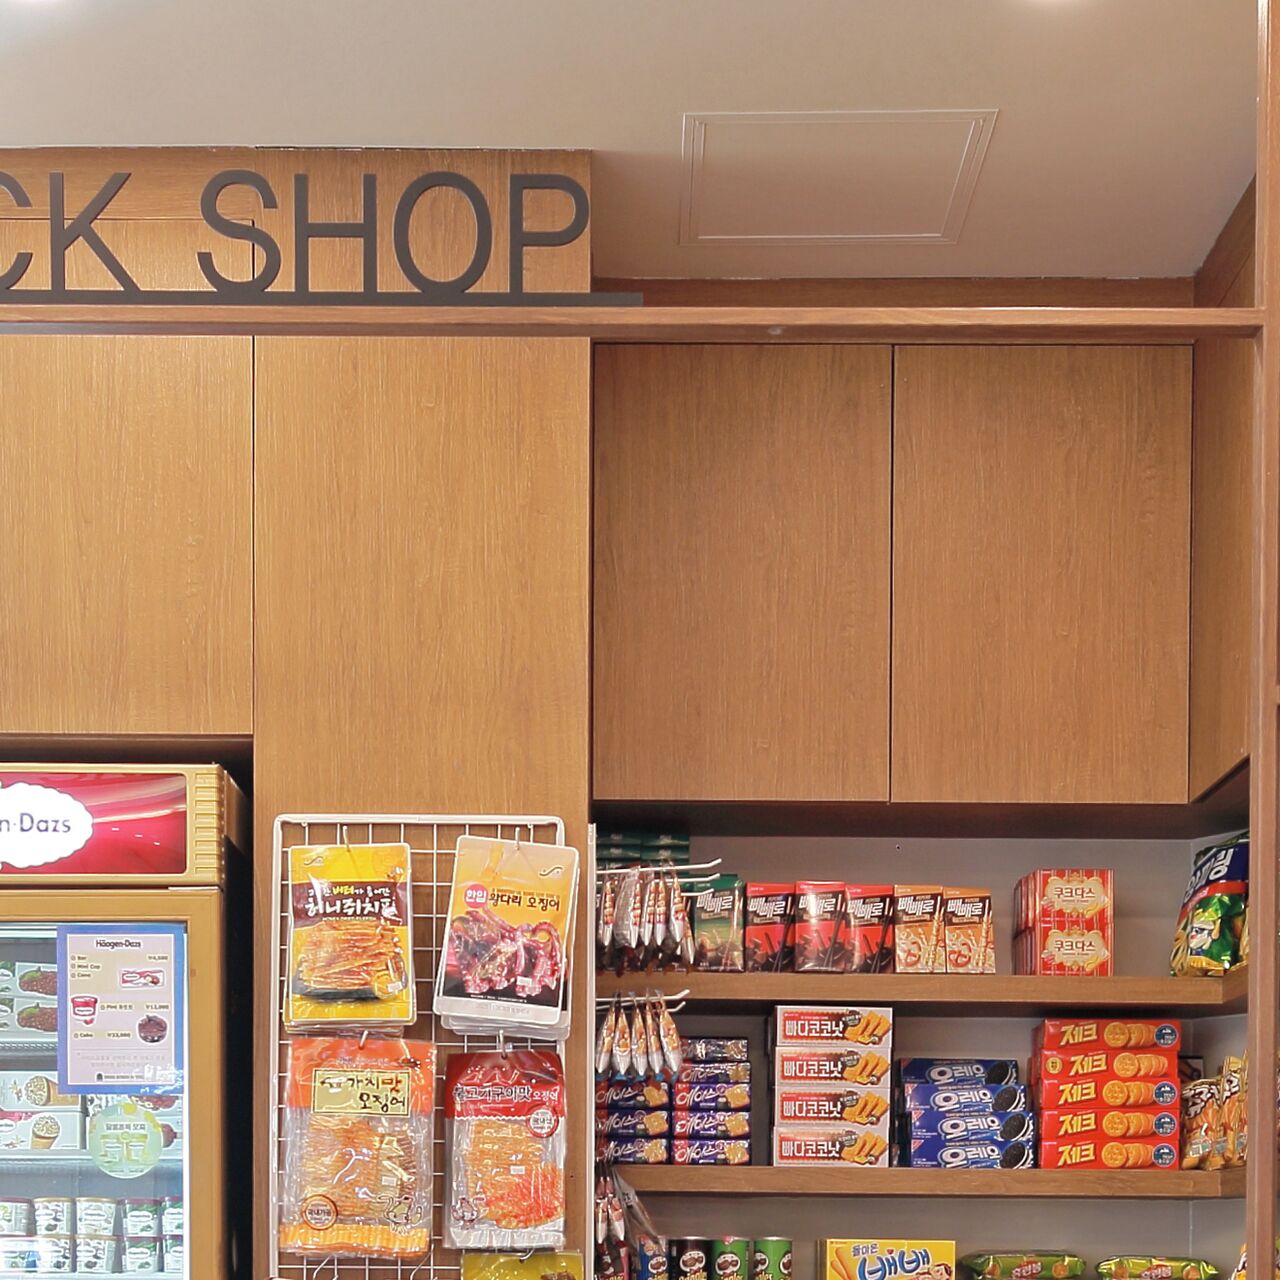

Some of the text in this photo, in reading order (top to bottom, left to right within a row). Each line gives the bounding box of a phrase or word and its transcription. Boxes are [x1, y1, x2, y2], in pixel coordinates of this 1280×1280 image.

[197, 168, 589, 294] SHOP
[466, 890, 487, 903] 한입
[489, 893, 522, 907] 왕다리
[526, 897, 560, 912] 오징어
[1054, 887, 1096, 899] 쿠크다스
[697, 894, 732, 915] 빼빼로
[749, 897, 785, 918] 빼빼로
[799, 894, 835, 914] 빼빼로
[848, 898, 883, 917] 빼빼로
[898, 896, 933, 915] 빼빼로
[947, 897, 983, 916] 빼빼로
[1054, 940, 1096, 951] 쿠크다스
[786, 1021, 844, 1037] 빠다코코낫
[1060, 1023, 1097, 1046] 제크
[784, 1061, 842, 1077] 빠다코코낫
[930, 1065, 984, 1084] 오레오
[1069, 1053, 1107, 1076] 제크
[359, 1092, 405, 1113] 오징어
[935, 1090, 992, 1111] 오레오
[1059, 1082, 1096, 1105] 제크
[783, 1101, 841, 1117] 빠다코코낫
[941, 1117, 1001, 1139] 오레오
[1059, 1113, 1096, 1136] 제크
[782, 1141, 840, 1157] 빠다코코낫
[941, 1145, 1001, 1167] 오레오
[1058, 1143, 1095, 1166] 제크
